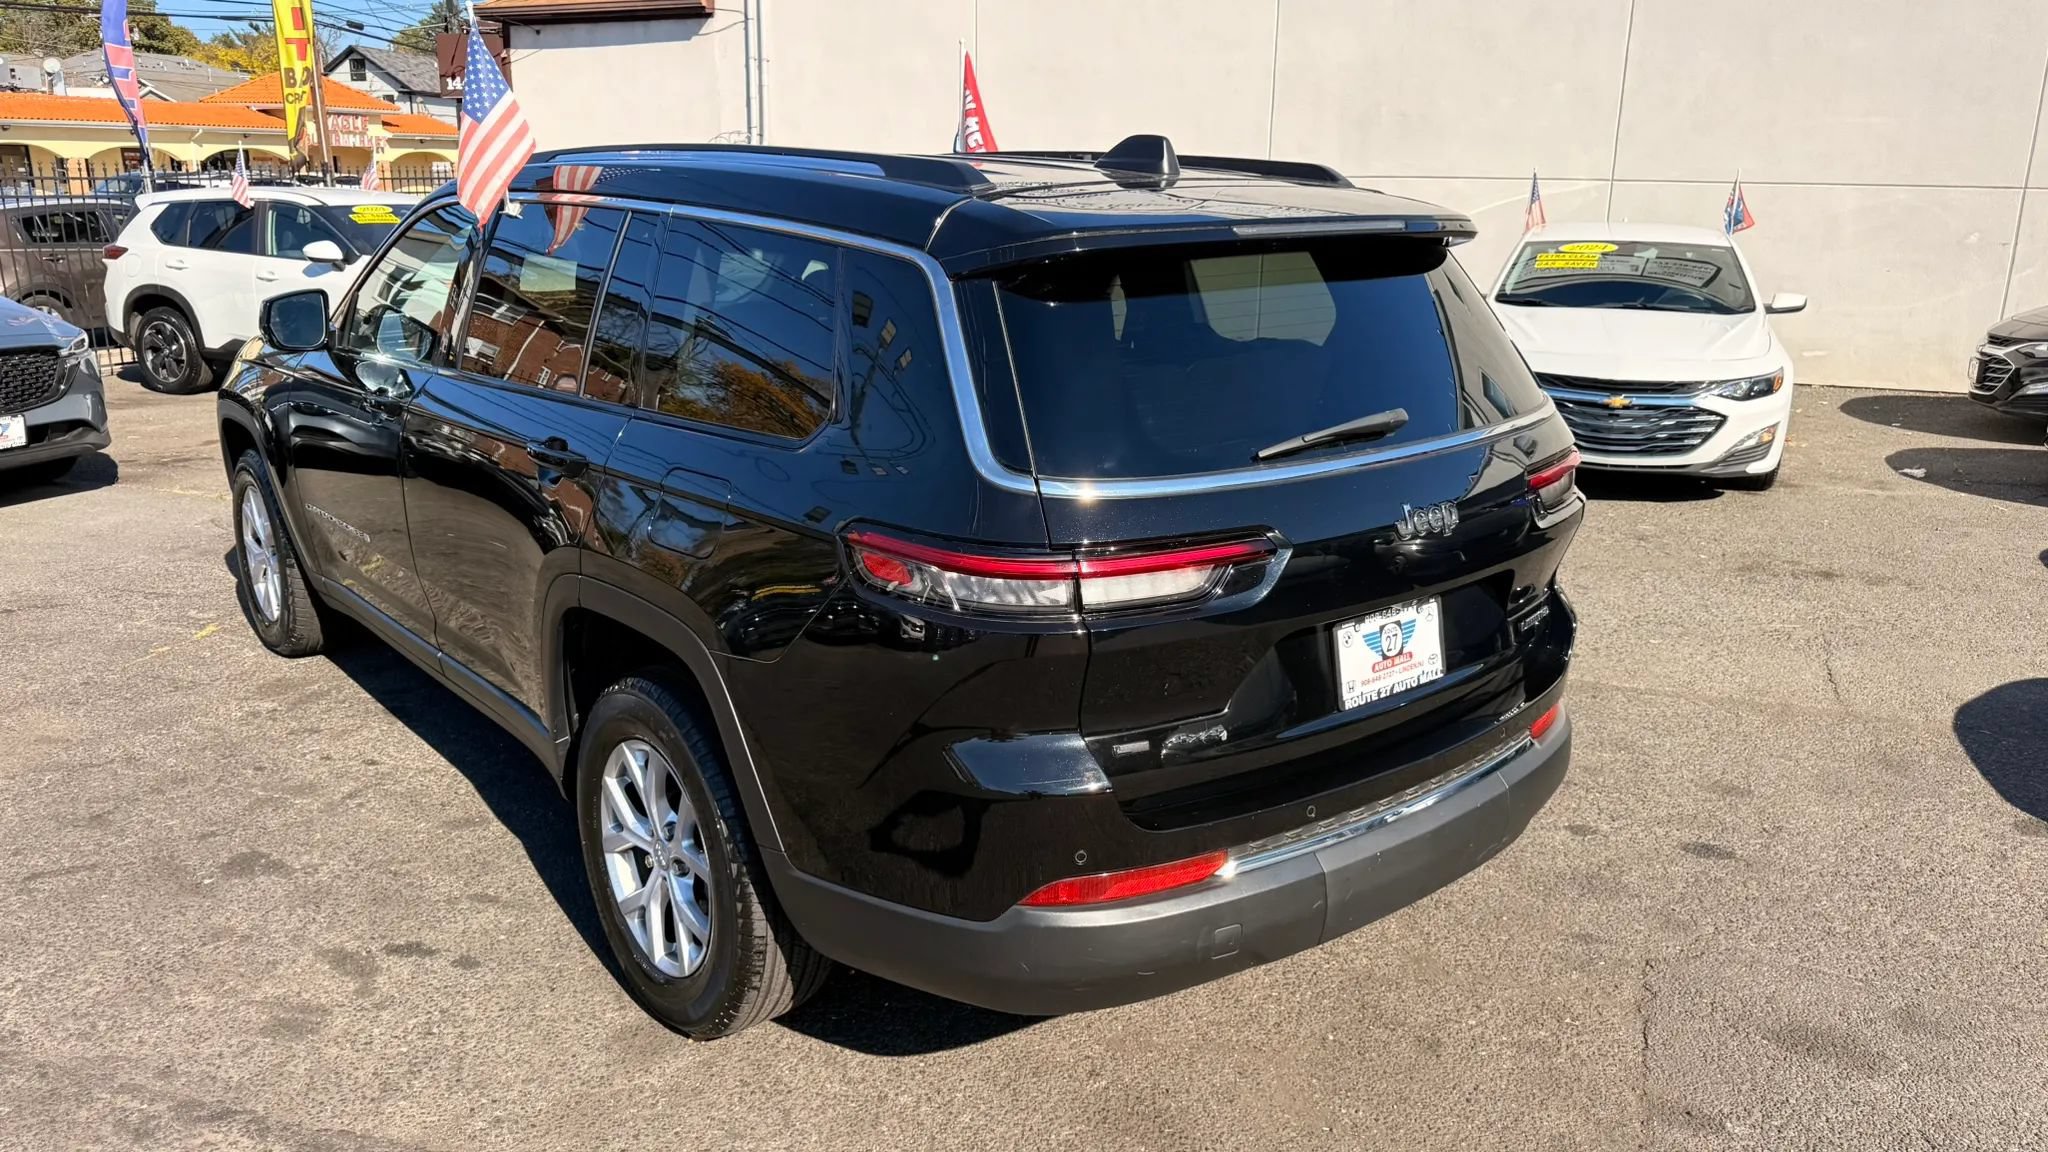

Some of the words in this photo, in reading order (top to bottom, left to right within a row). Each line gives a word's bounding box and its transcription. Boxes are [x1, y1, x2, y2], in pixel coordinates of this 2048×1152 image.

[446, 76, 465, 90] 14
[1395, 503, 1459, 540] Jeep
[1385, 633, 1398, 652] 27
[1374, 661, 1393, 673] AUTO
[1395, 653, 1411, 665] MALL
[1345, 689, 1378, 710] ROUTE
[1380, 685, 1392, 698] 27
[1393, 678, 1418, 693] AUTO
[1419, 669, 1444, 685] MALL
